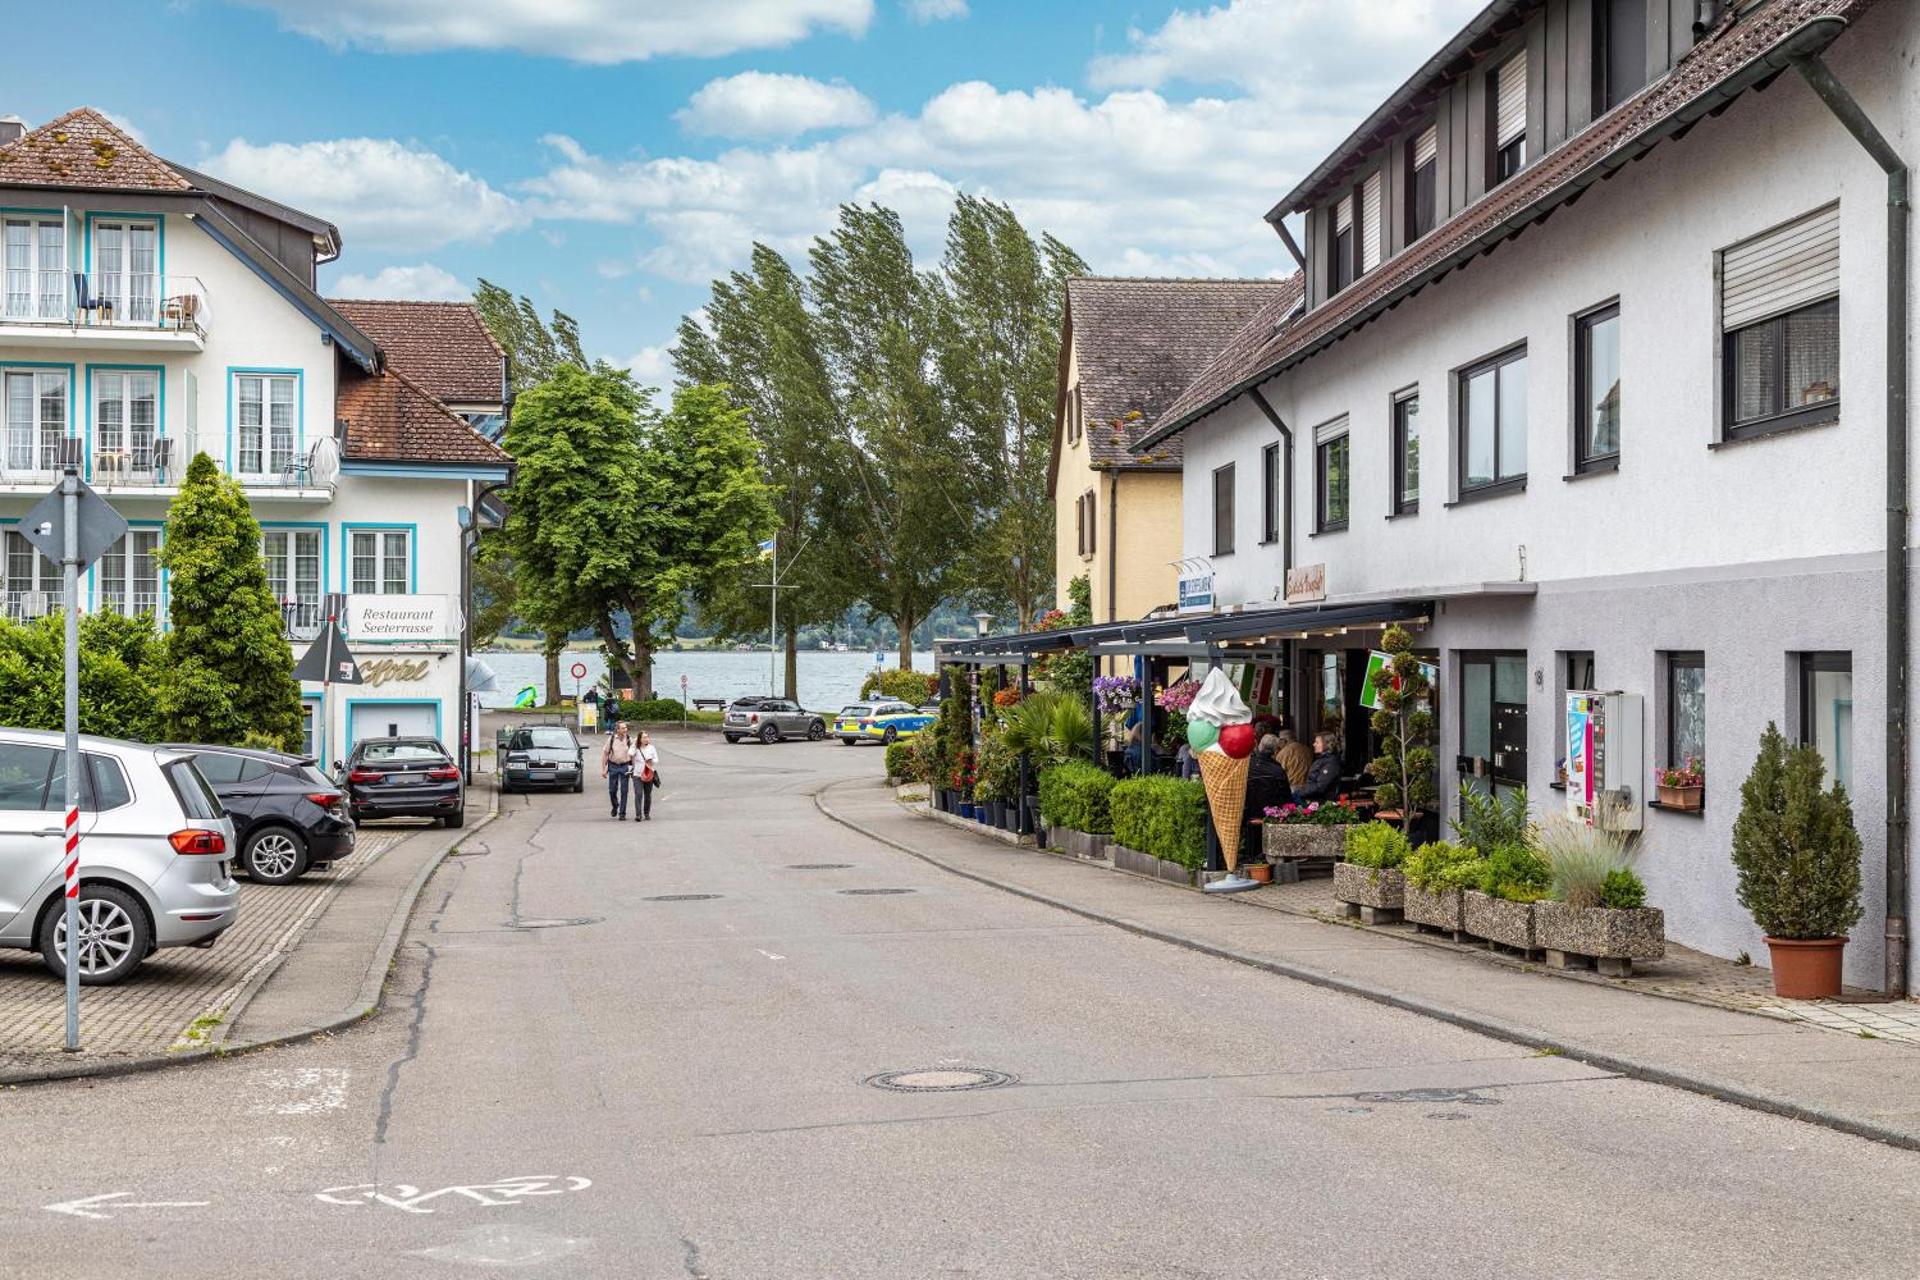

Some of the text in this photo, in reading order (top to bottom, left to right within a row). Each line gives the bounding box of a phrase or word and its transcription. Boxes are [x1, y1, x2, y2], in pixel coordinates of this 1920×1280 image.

[362, 608, 434, 620] Restaurant
[361, 621, 434, 633] Seeterrasse
[358, 657, 430, 688] Hotel
[1251, 669, 1263, 699] EIS
